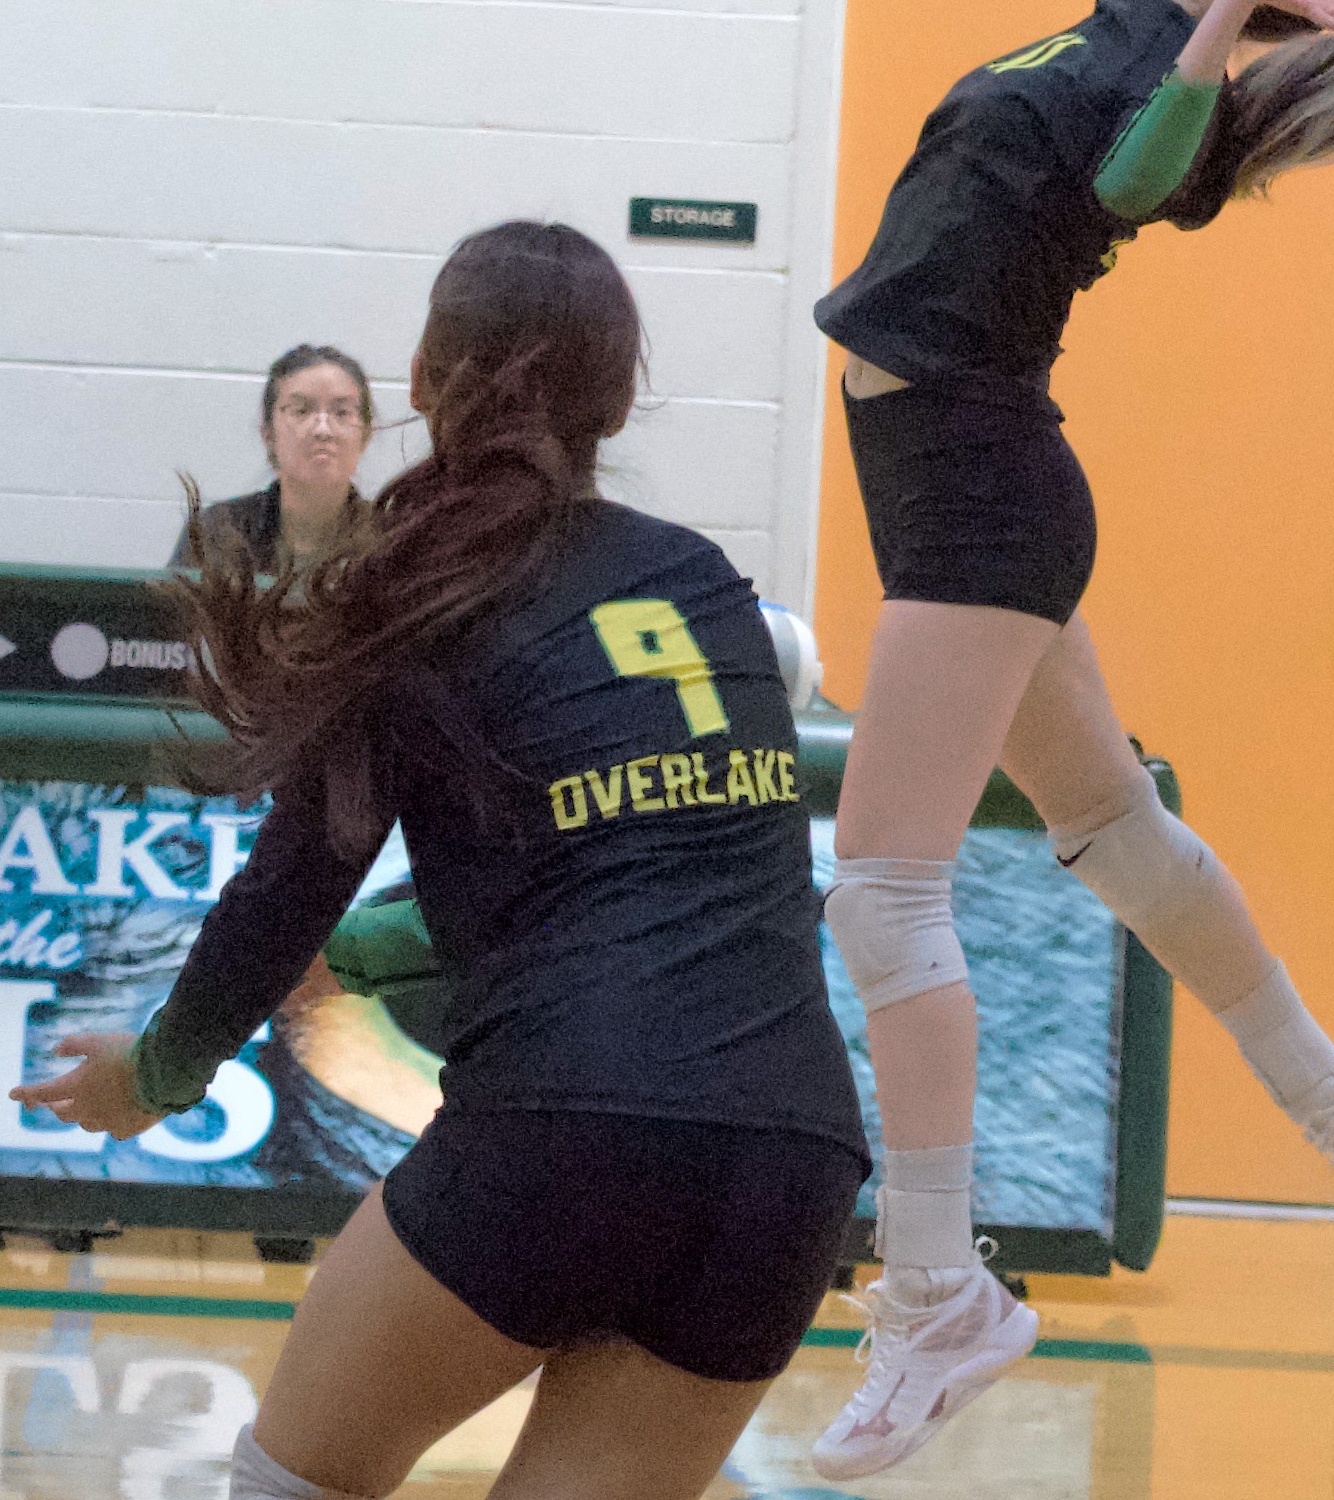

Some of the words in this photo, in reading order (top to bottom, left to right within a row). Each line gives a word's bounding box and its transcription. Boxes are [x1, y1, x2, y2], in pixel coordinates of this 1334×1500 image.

[649, 205, 736, 228] STORAGE
[109, 636, 188, 671] BONUS
[589, 598, 729, 739] 9
[547, 747, 802, 832] OVERLAKE
